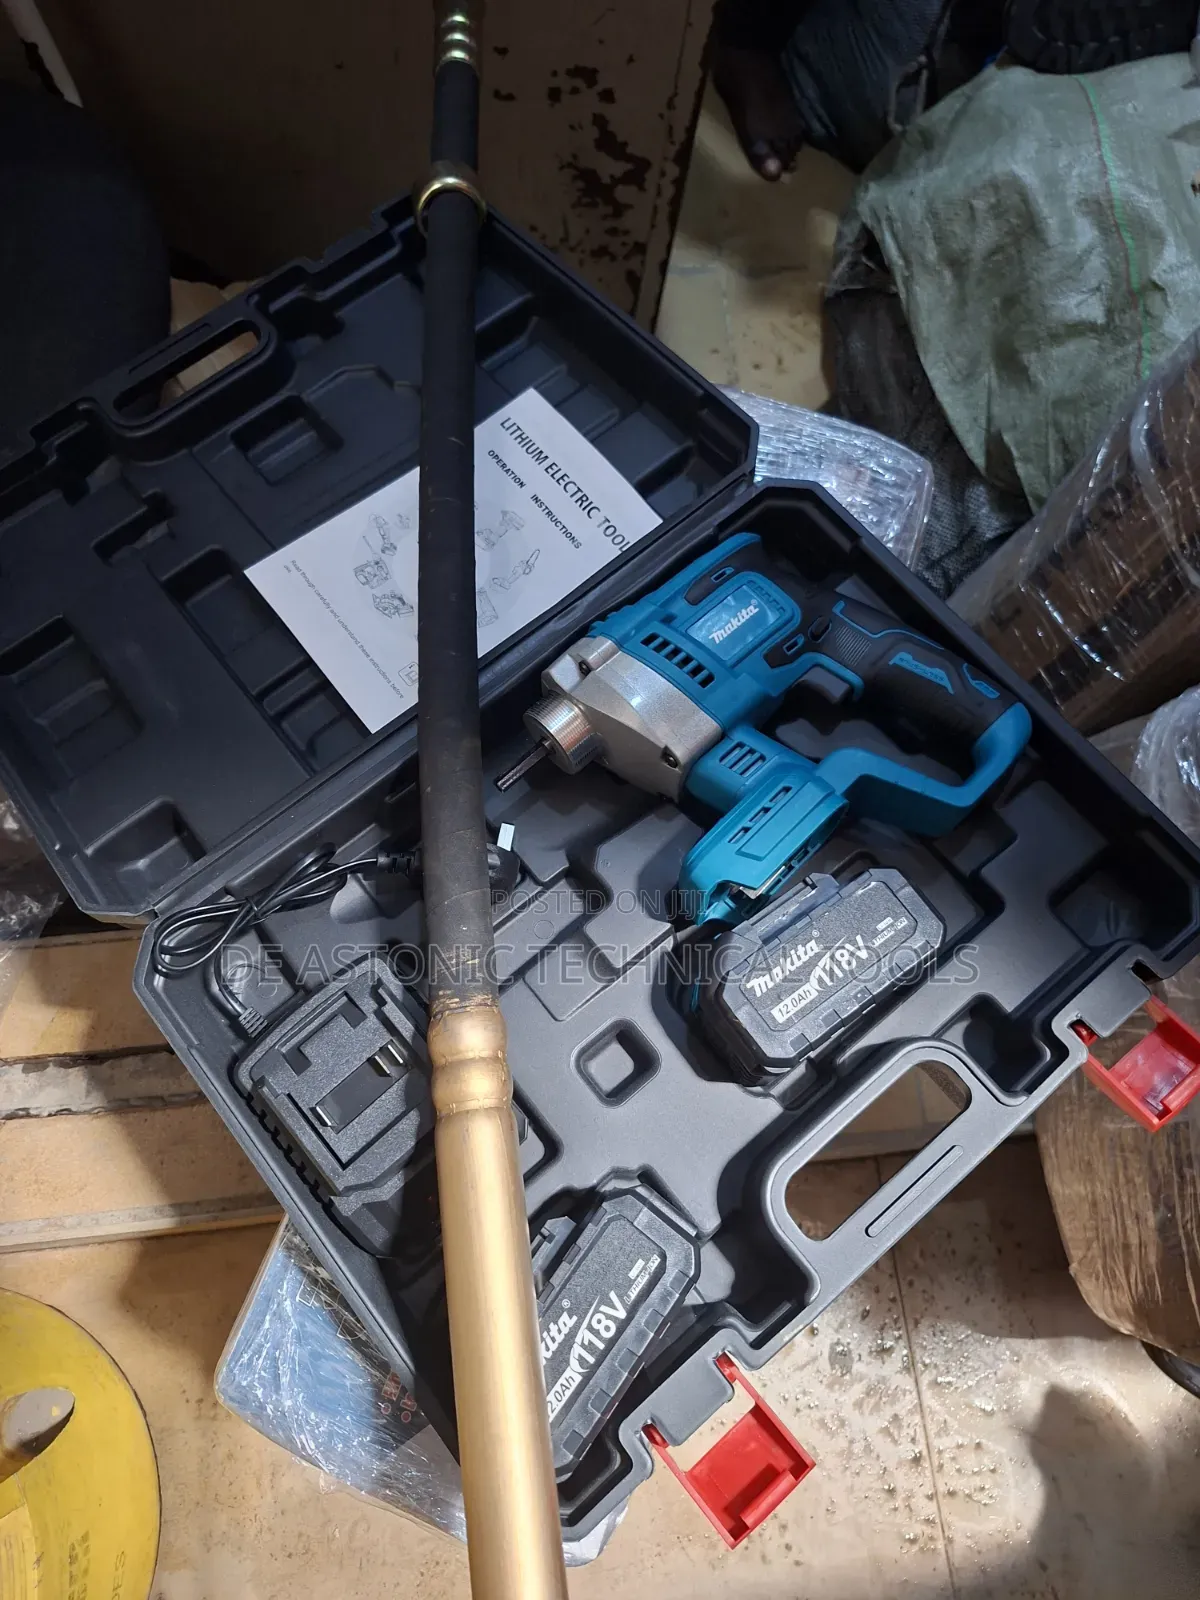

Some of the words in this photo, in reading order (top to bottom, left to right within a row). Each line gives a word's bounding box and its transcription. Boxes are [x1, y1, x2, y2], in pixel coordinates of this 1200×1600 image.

[488, 449, 526, 489] OPERATION
[530, 494, 582, 549] INSTRUCTIONS
[500, 417, 549, 466] LITHIUM
[544, 462, 601, 519] ELECTRIC
[776, 988, 812, 1018] 12.0Ah
[547, 1375, 577, 1415] 2.0Ah
